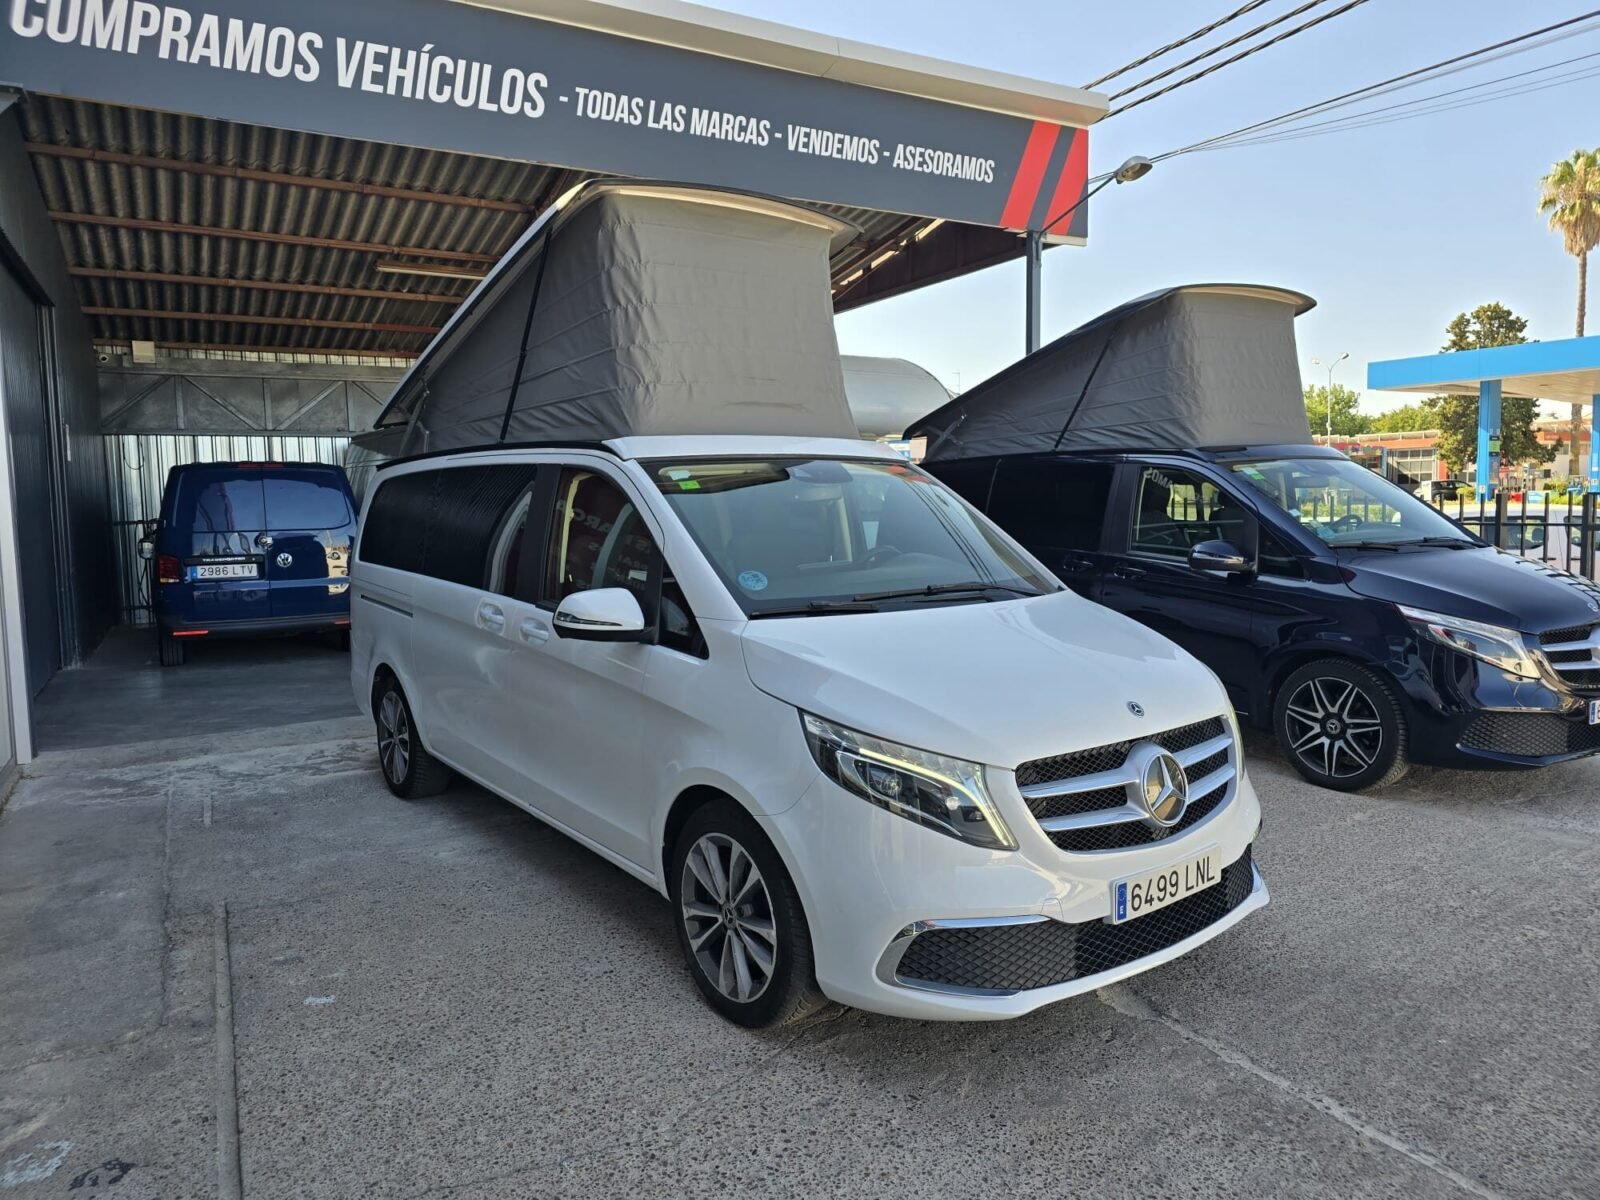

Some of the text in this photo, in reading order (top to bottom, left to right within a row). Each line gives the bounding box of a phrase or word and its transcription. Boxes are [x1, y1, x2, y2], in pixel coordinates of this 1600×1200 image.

[11, 0, 324, 83] COMPRAMOS
[336, 36, 548, 119] VEHÍCULOS
[575, 86, 643, 126] TODAS
[647, 100, 687, 134] LAS
[689, 107, 771, 147] MARCAS
[787, 124, 880, 166] VENDEMOS
[892, 143, 996, 184] ASESORAMOS
[200, 565, 254, 577] 2986 LTV
[1131, 870, 1179, 912] 6499
[1185, 856, 1215, 892] LNL
